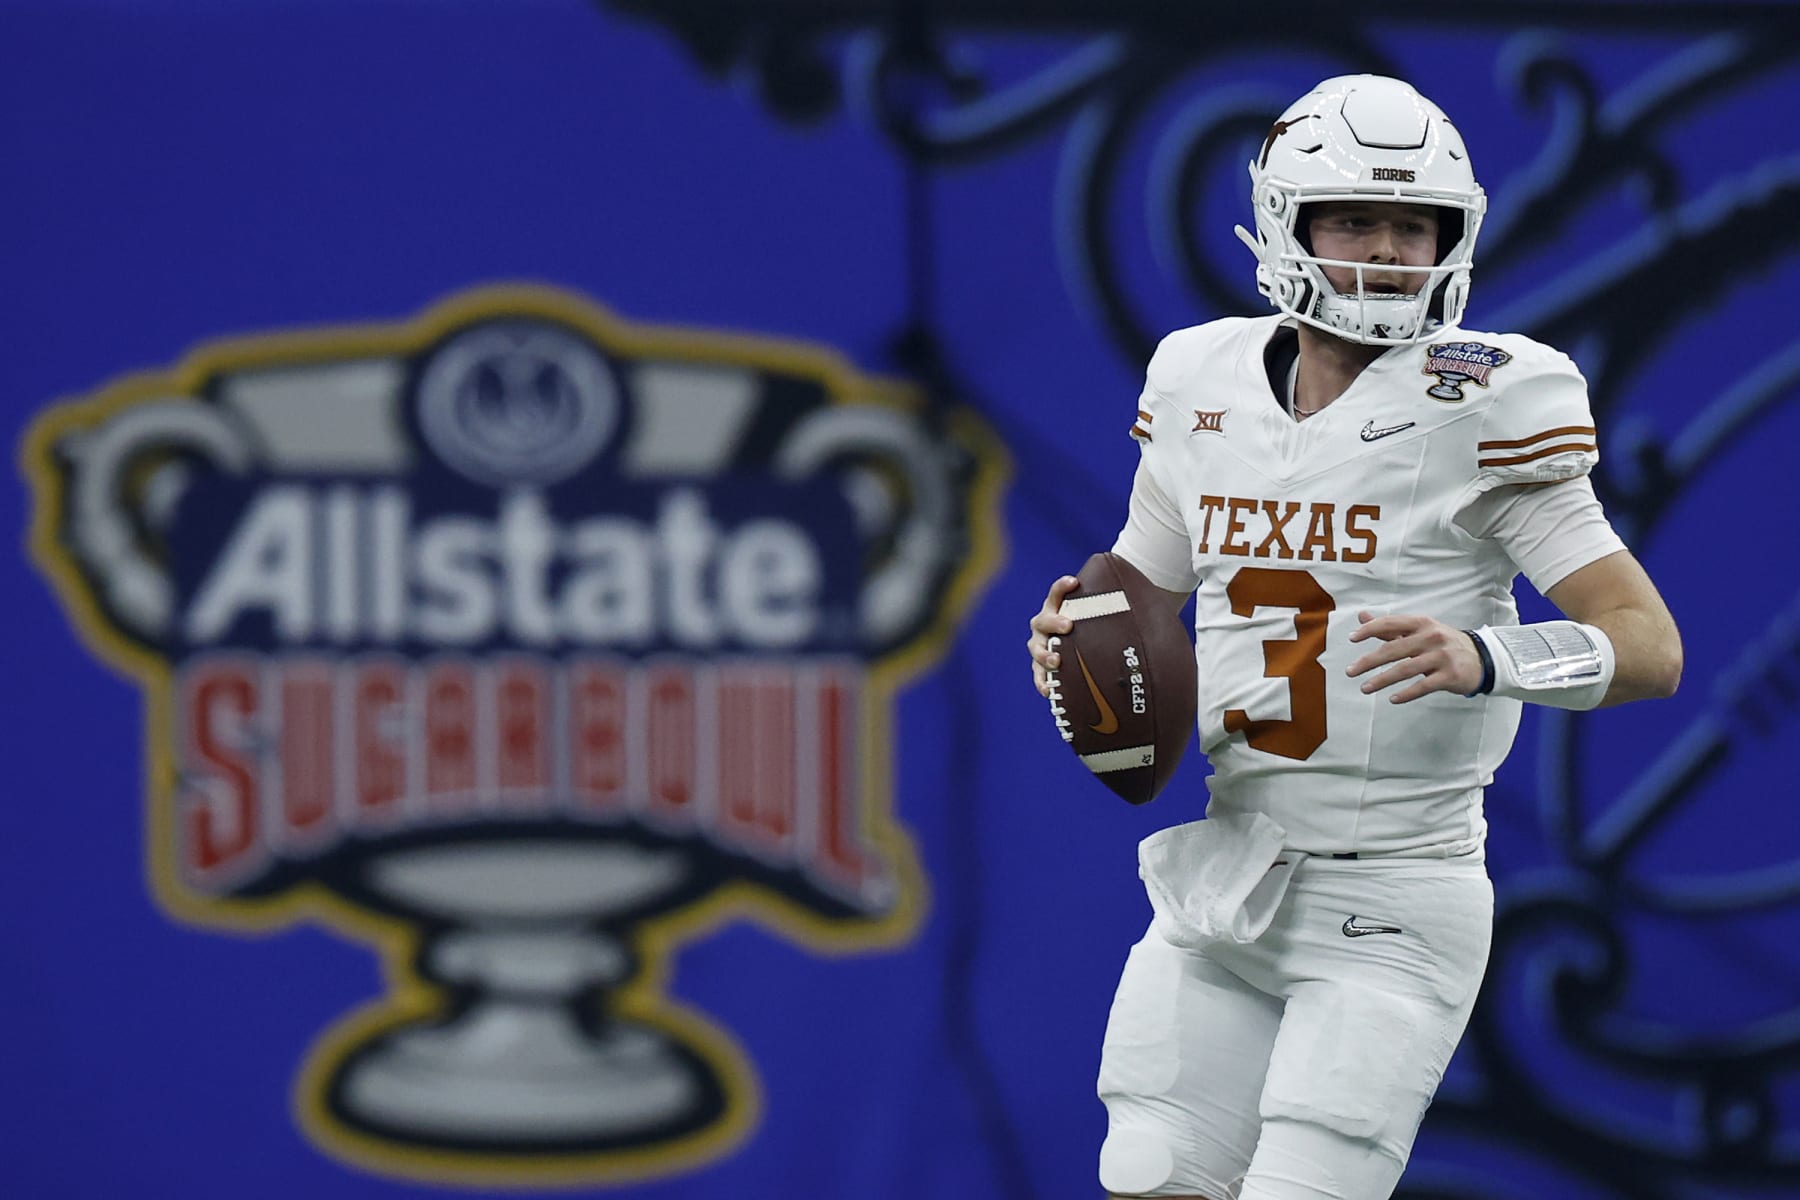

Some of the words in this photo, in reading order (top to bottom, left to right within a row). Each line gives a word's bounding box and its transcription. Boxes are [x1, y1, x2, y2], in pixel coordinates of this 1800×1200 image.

[1372, 167, 1416, 183] HORNS
[1436, 348, 1493, 364] Allstate
[1191, 409, 1228, 433] XII
[1199, 494, 1381, 563] TEXAS
[186, 484, 824, 645] Allstate
[1223, 566, 1336, 761] 3
[178, 660, 558, 880] SUGAR
[564, 660, 880, 895] BOWL
